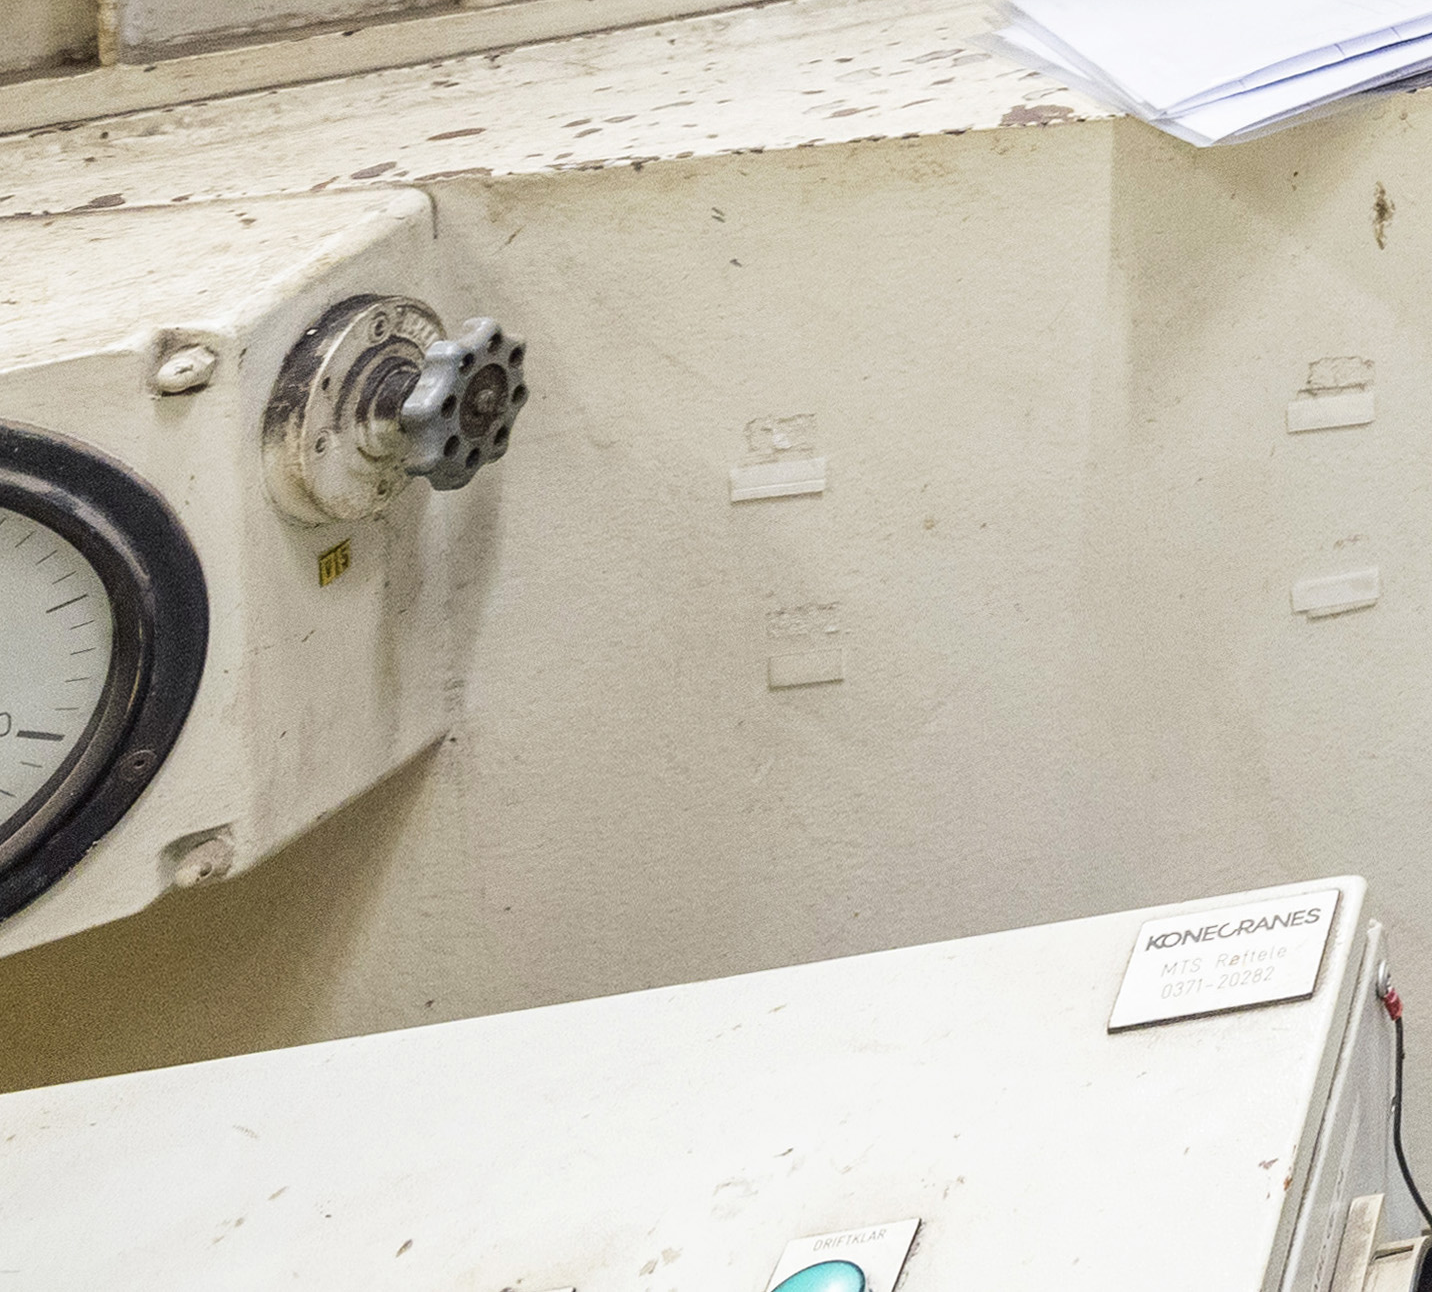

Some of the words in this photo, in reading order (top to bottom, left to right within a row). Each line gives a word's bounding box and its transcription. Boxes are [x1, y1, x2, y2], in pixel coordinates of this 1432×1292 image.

[1145, 907, 1322, 952] KONECRANES
[1160, 957, 1202, 978] MTS
[1161, 966, 1276, 1000] 0371-20282
[813, 1228, 887, 1252] DRIFTKLAR
